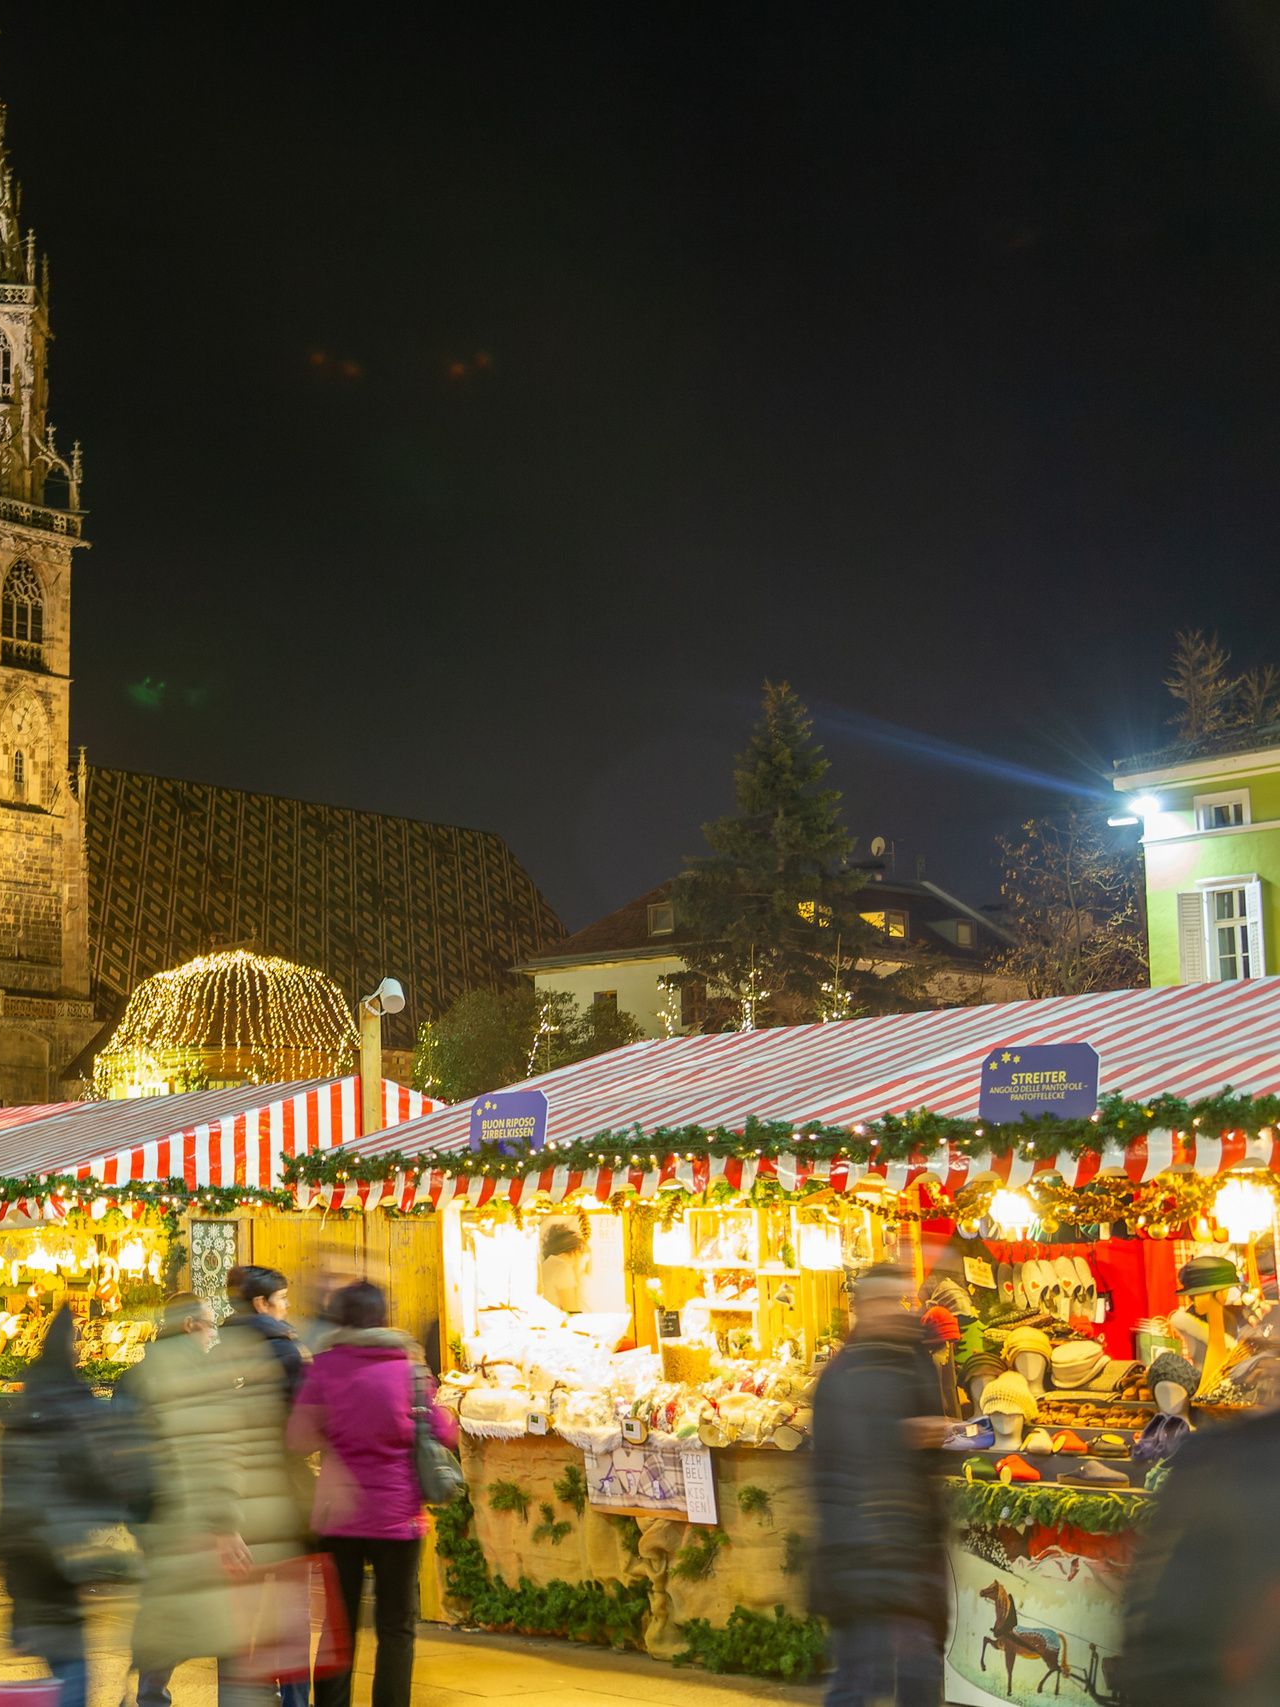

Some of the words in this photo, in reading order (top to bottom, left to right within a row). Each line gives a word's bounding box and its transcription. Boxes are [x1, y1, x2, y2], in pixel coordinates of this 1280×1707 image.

[1011, 1071, 1067, 1085] STREITER
[989, 1085, 1019, 1094] ANGOLO
[1020, 1084, 1040, 1092] DELLE
[1042, 1082, 1082, 1091] PANTOFOLE
[1010, 1091, 1065, 1101] PANTOFFELECKE
[482, 1119, 505, 1129] BUON
[506, 1117, 536, 1128] RIPOSO
[482, 1127, 534, 1139] ZIRBELKISSEN
[205, 1255, 218, 1268] 50
[684, 1454, 701, 1466] ZIR
[686, 1467, 703, 1479] BEL
[687, 1487, 705, 1500] KIS
[689, 1501, 706, 1513] SEN
